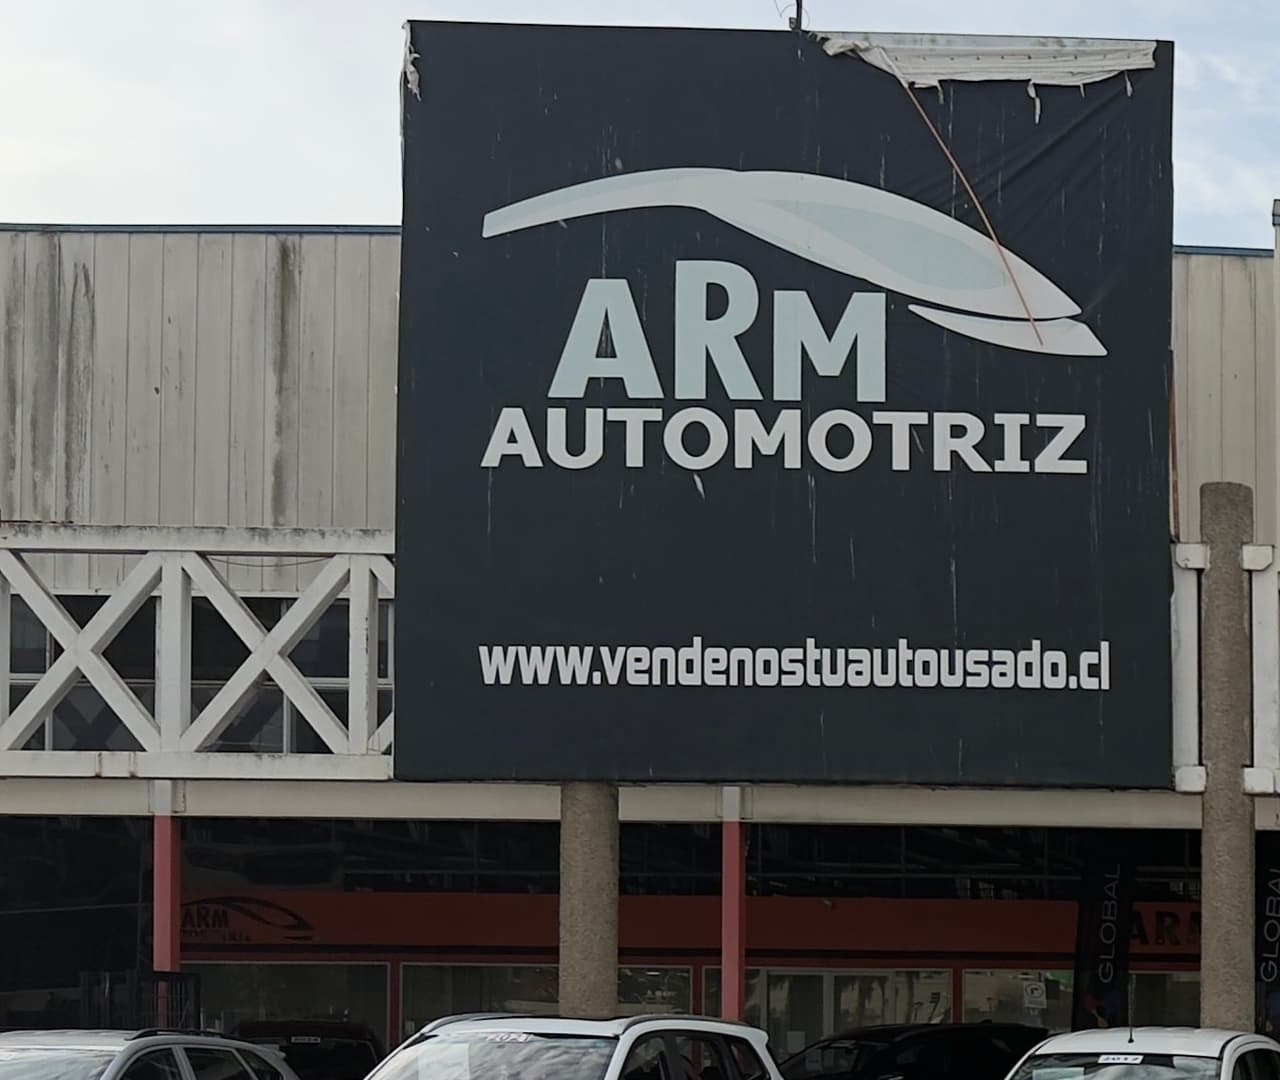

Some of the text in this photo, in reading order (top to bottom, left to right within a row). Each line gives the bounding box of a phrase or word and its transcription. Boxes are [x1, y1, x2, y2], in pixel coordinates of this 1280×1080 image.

[547, 260, 887, 403] ARM
[480, 407, 1089, 475] AUTOMOTRIZ
[478, 635, 1111, 691] www.vendenostuautousado.cl
[1098, 863, 1121, 984] GLOBAL
